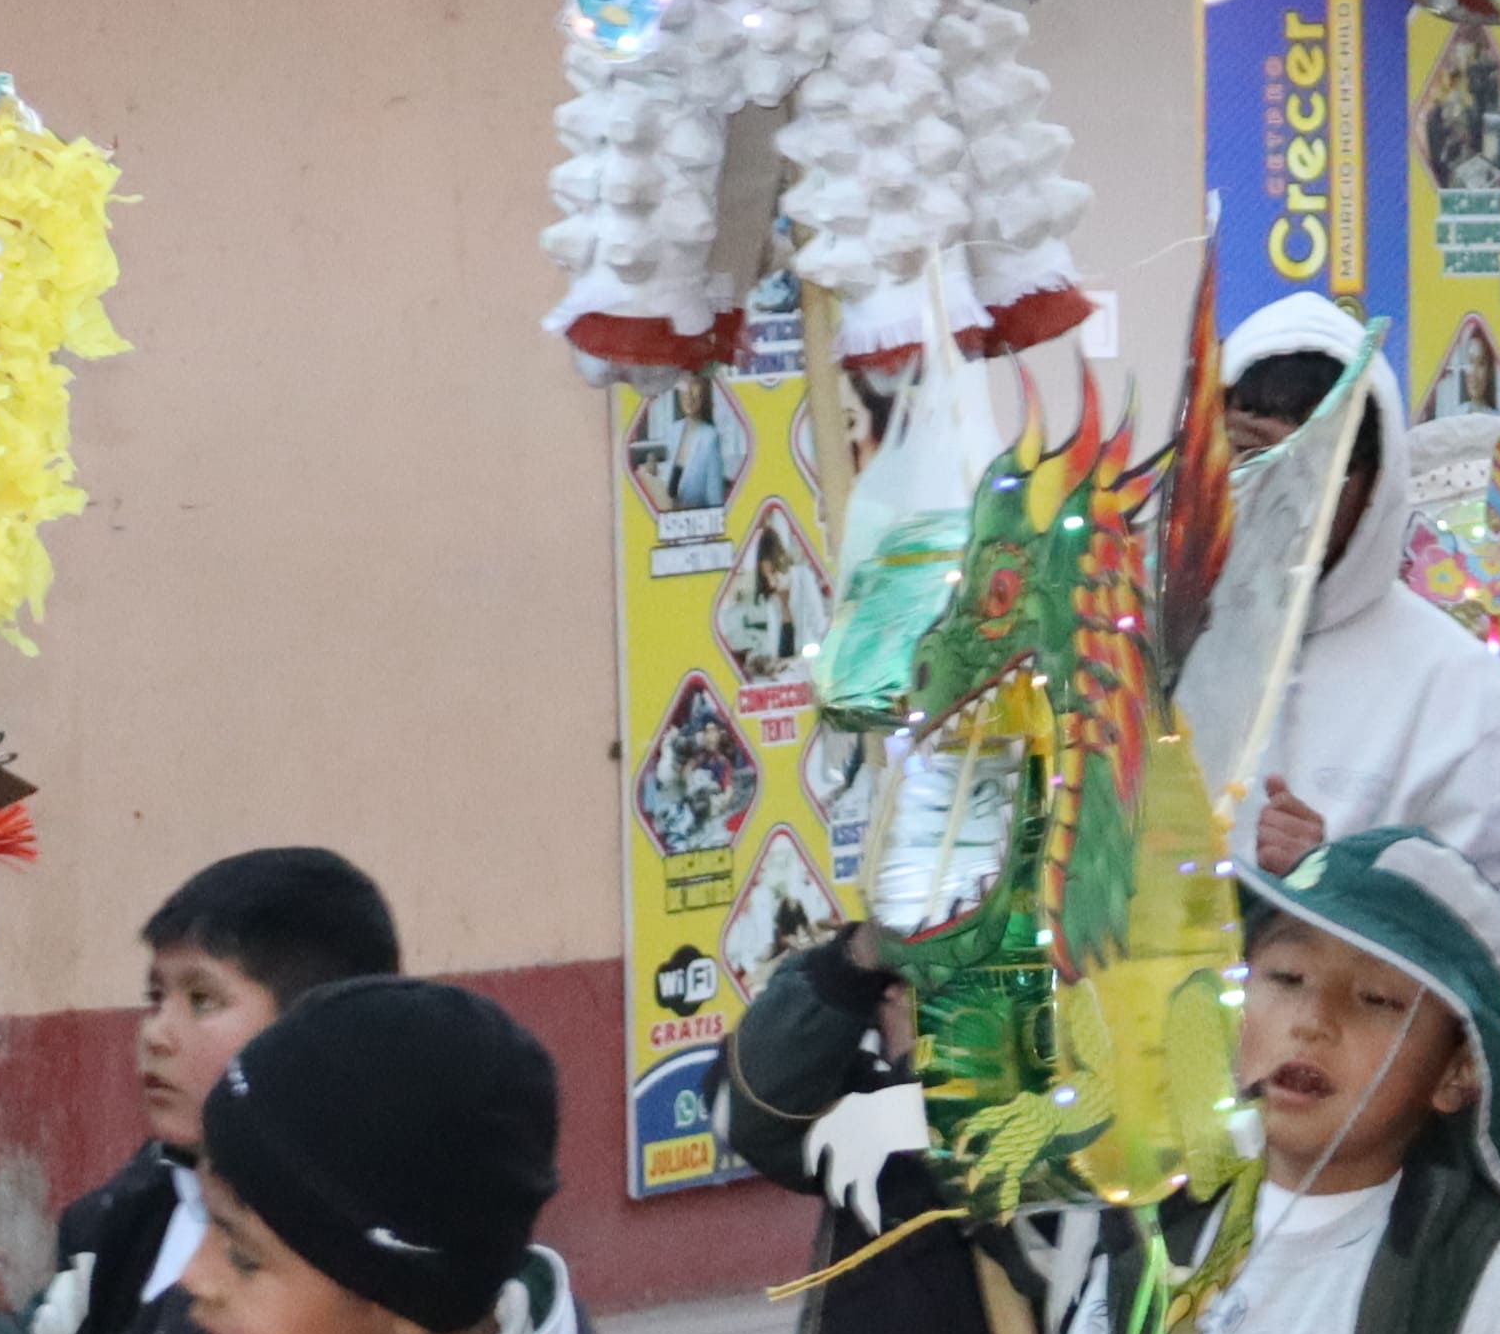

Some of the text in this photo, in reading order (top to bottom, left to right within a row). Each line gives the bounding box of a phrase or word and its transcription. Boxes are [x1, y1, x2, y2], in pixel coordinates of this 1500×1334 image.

[1264, 55, 1286, 198] CETPRO
[1267, 11, 1328, 282] Crecer
[650, 1014, 724, 1048] GRATIS
[650, 1141, 710, 1179] JULIACA
